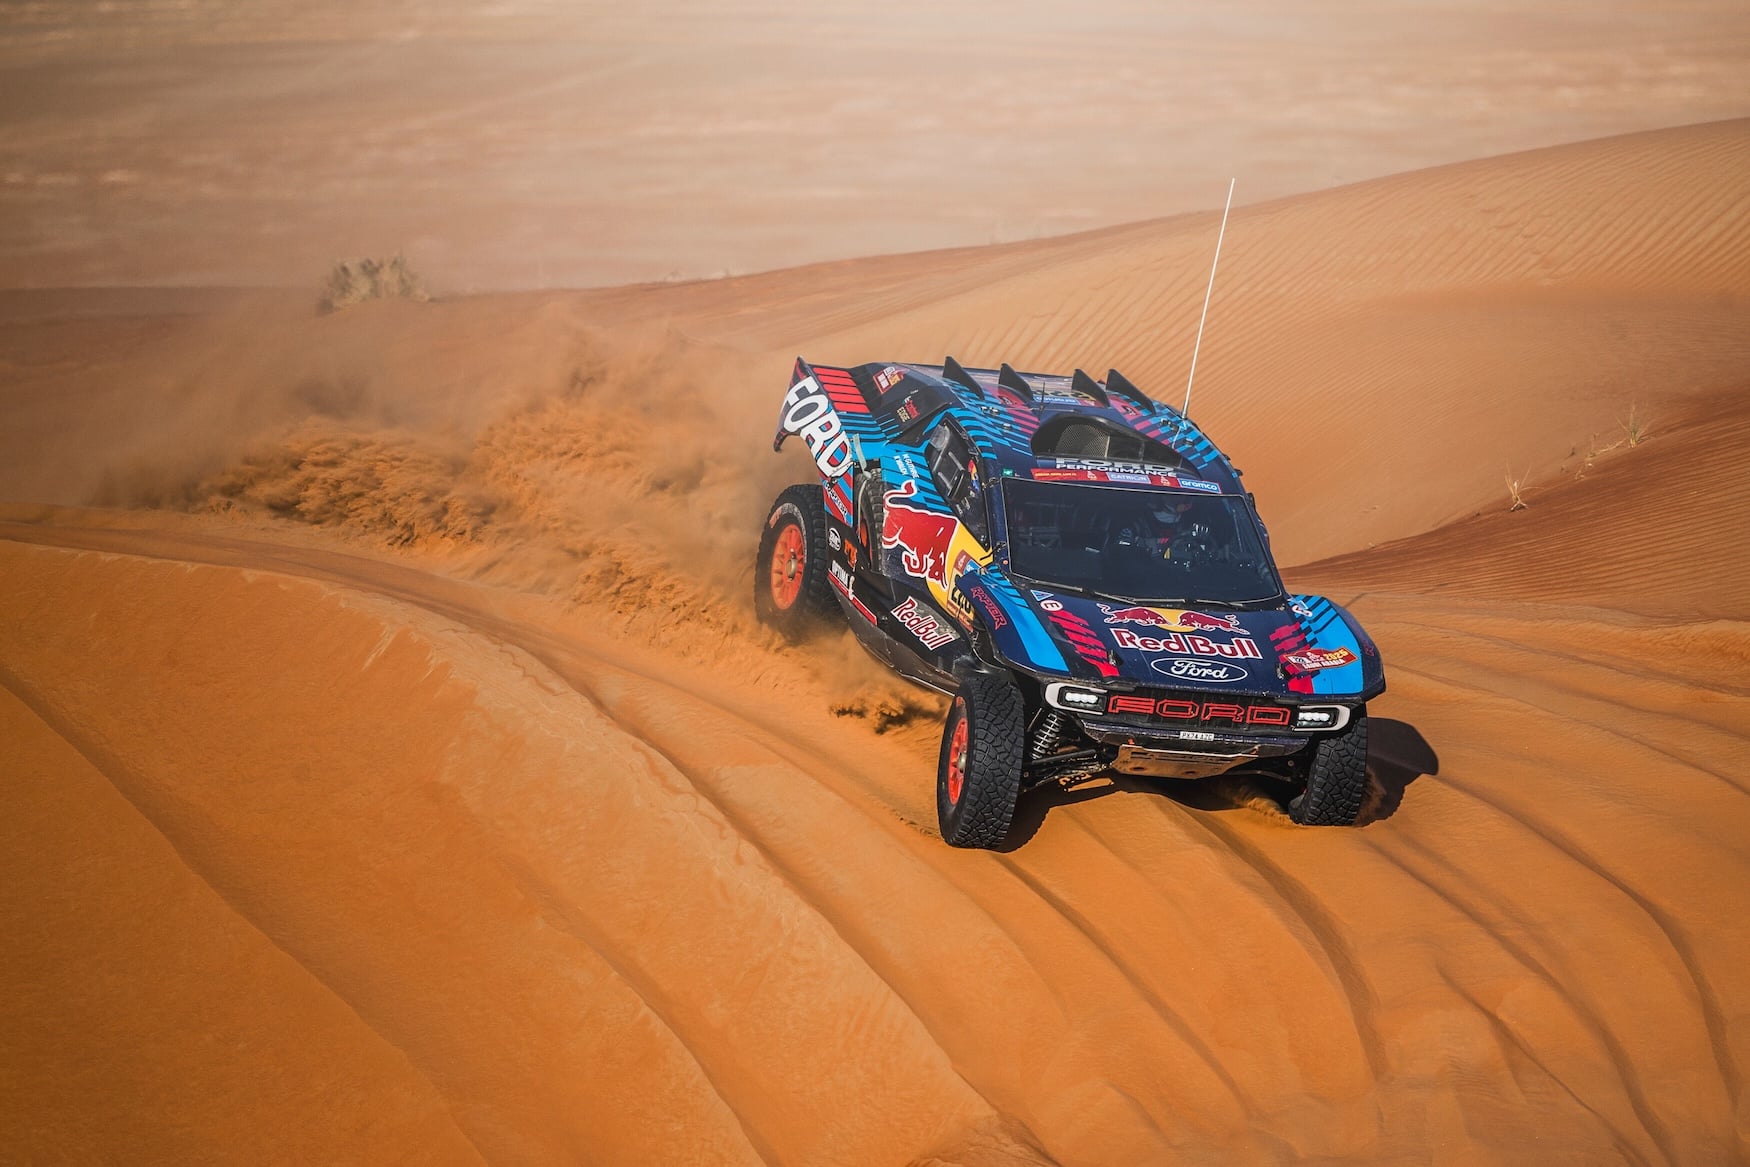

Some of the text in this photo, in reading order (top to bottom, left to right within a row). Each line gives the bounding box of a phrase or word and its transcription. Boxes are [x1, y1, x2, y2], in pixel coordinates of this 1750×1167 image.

[783, 376, 854, 478] FORD
[1055, 457, 1174, 473] FORD
[1055, 463, 1178, 478] PERFORMANCE
[1181, 480, 1218, 491] aramco
[970, 586, 1007, 630] RAPTOR
[1323, 649, 1348, 661] 2025
[1170, 659, 1229, 679] Ford
[1108, 695, 1290, 725] FORD
